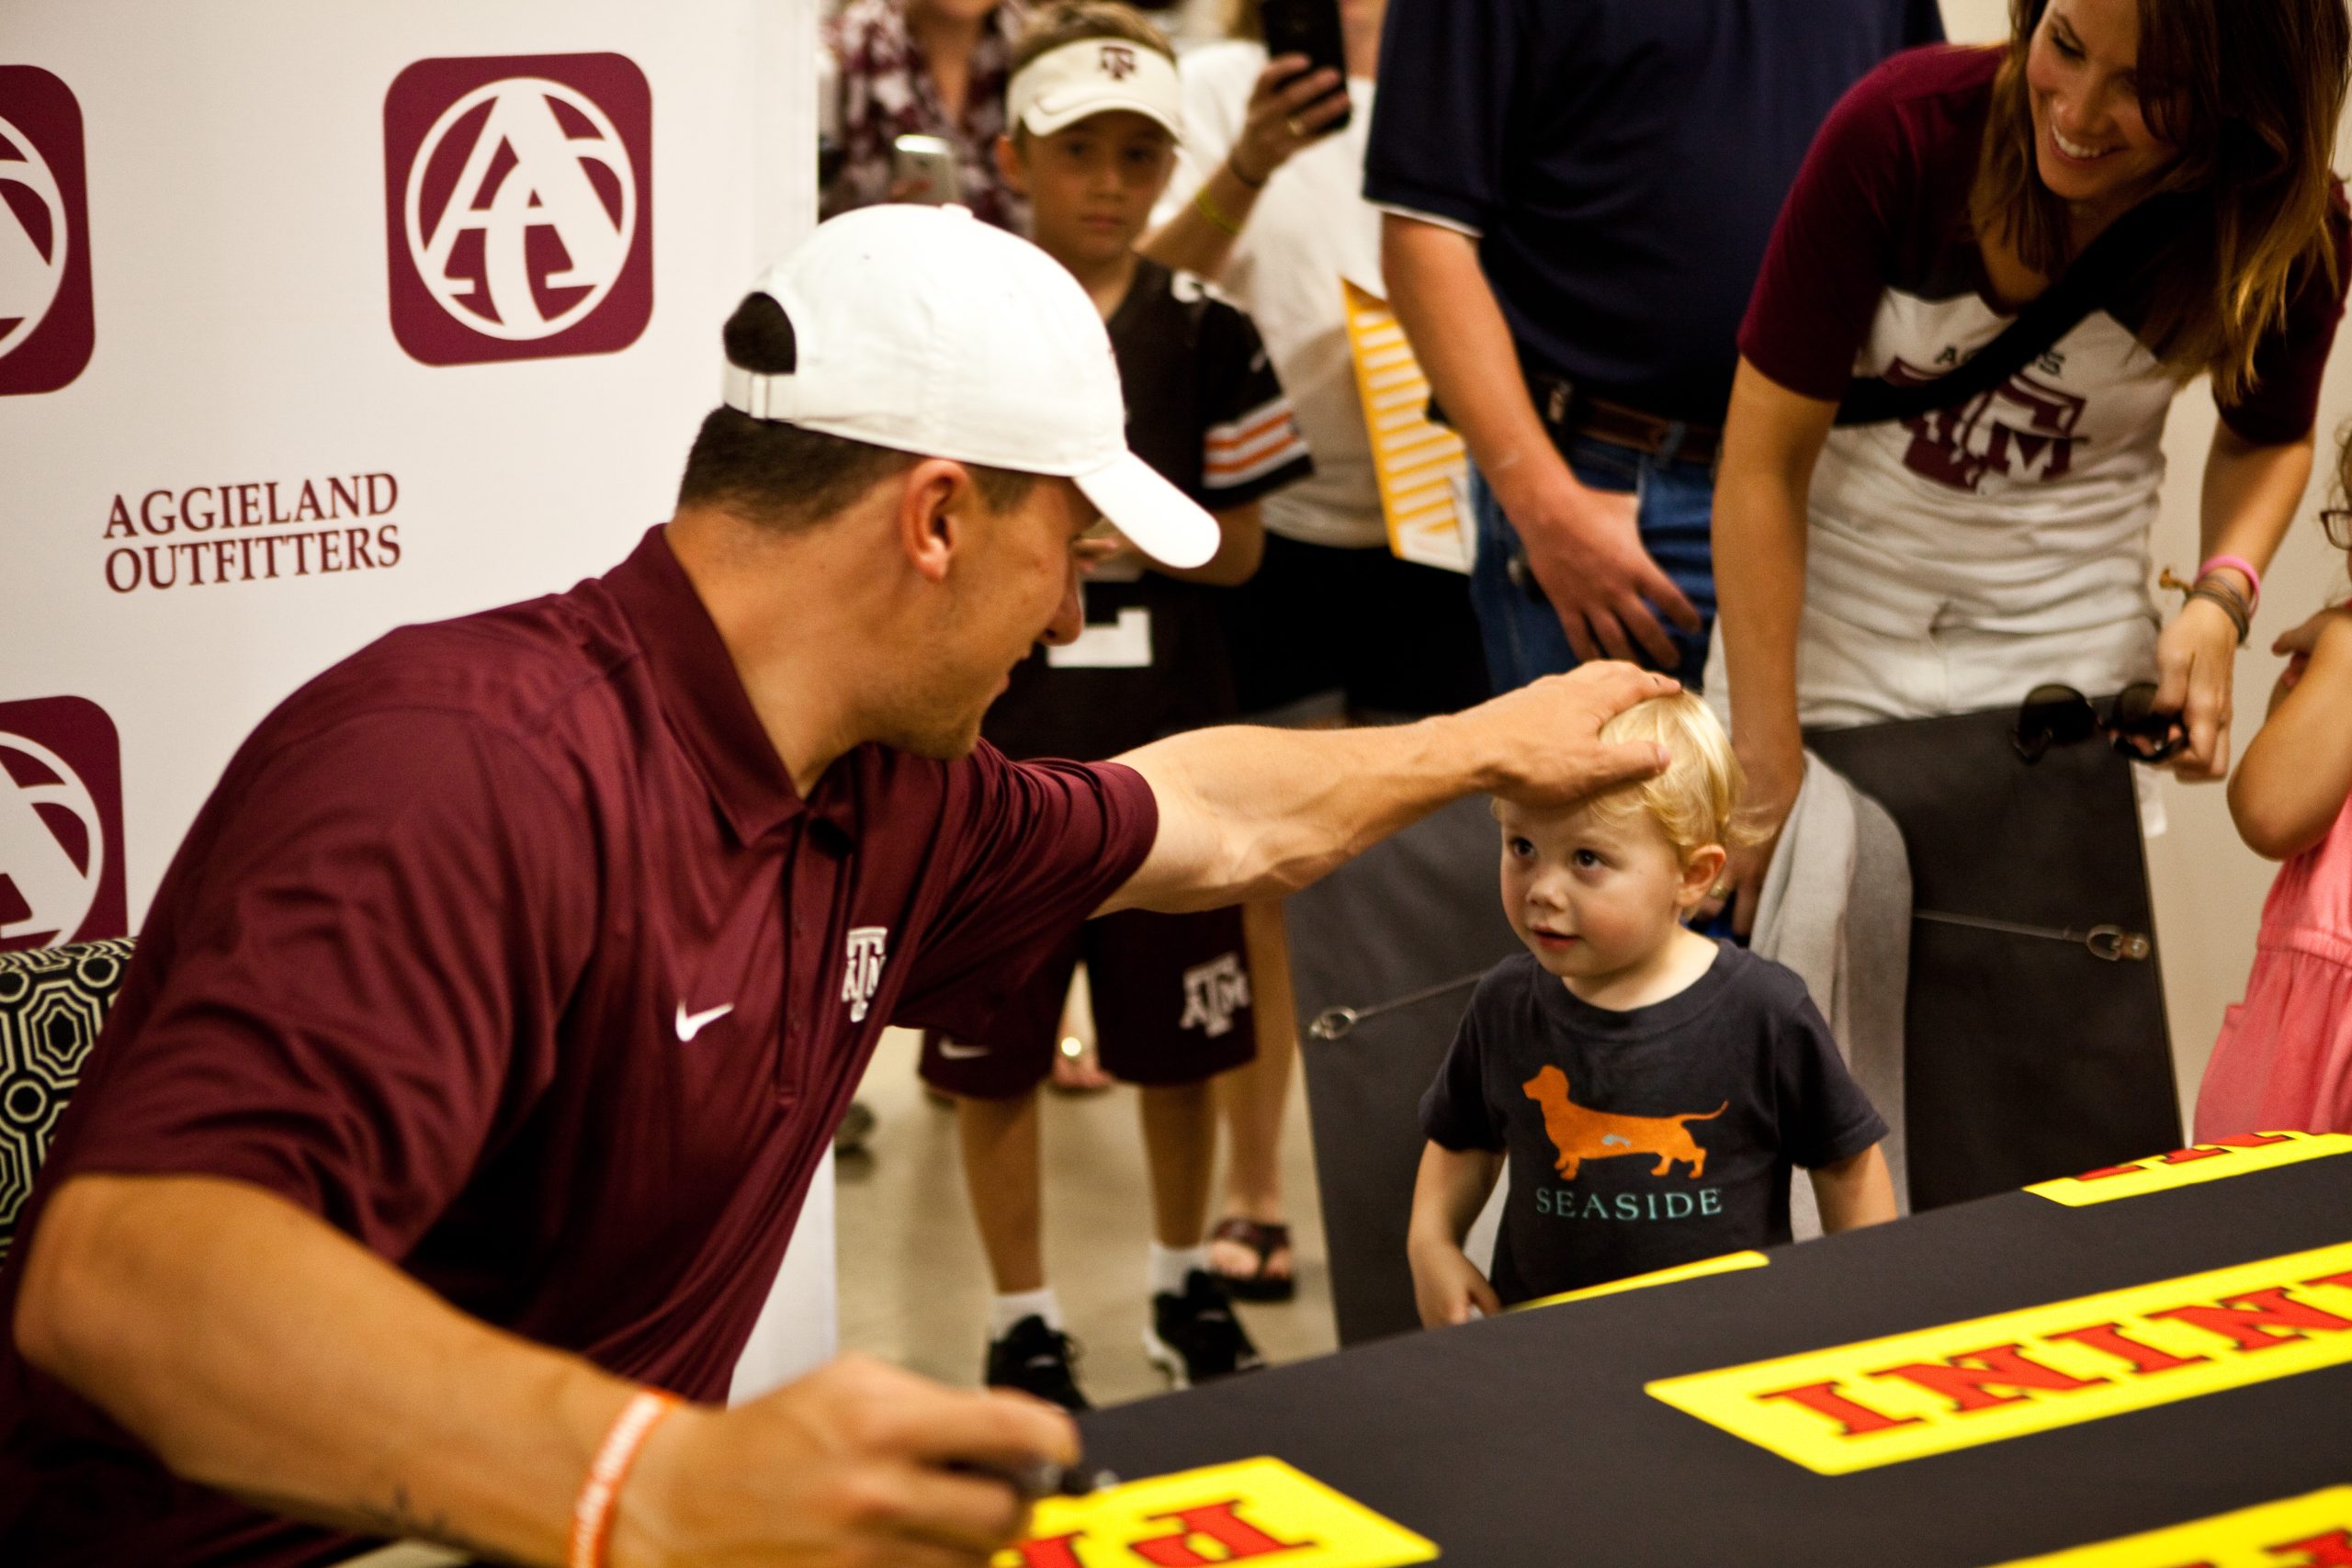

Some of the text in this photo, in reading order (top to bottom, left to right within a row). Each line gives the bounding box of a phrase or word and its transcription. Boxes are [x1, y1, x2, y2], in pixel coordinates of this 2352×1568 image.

[103, 472, 399, 539] AGGIELAND
[105, 525, 401, 593] OUTFITTERS
[1535, 1187, 1724, 1221] SEASIDE
